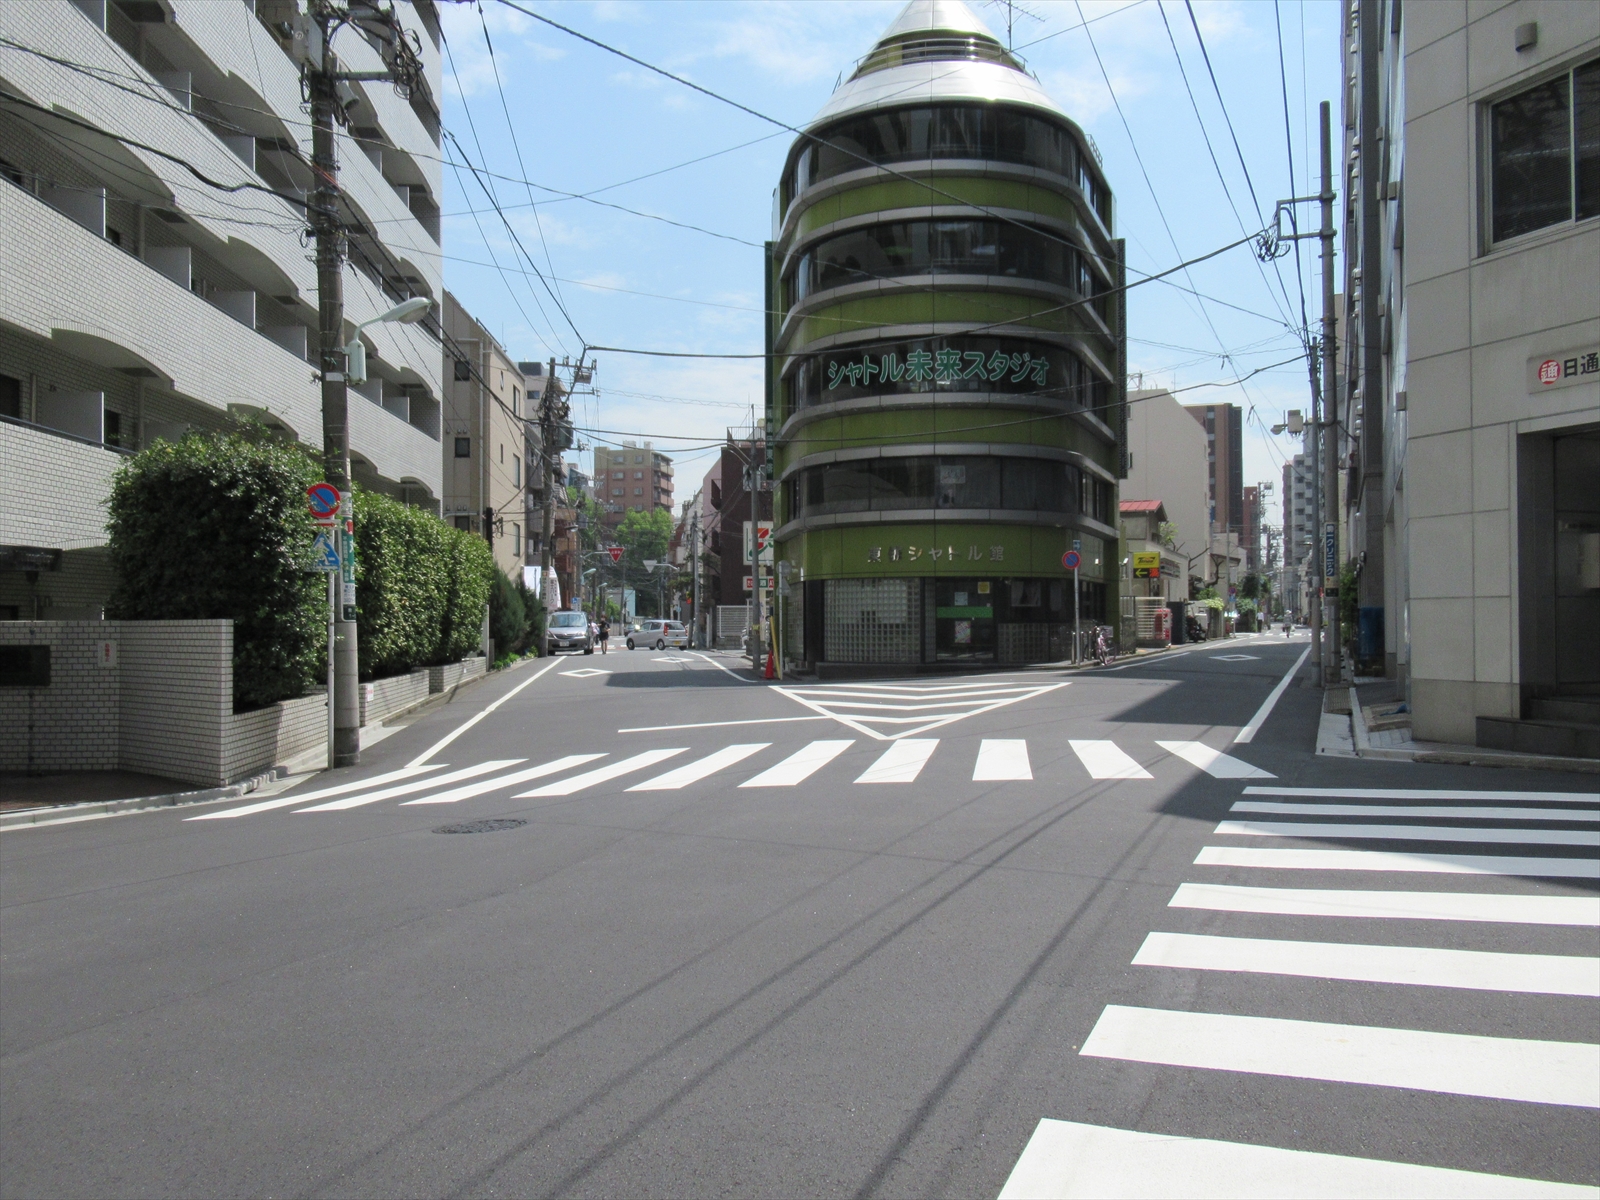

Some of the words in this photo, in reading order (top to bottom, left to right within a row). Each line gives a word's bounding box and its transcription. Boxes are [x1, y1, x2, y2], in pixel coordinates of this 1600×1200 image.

[828, 348, 1050, 390] シャトル未来スタジオ
[1563, 352, 1600, 379] 日通
[1326, 525, 1335, 576] 一クリニック
